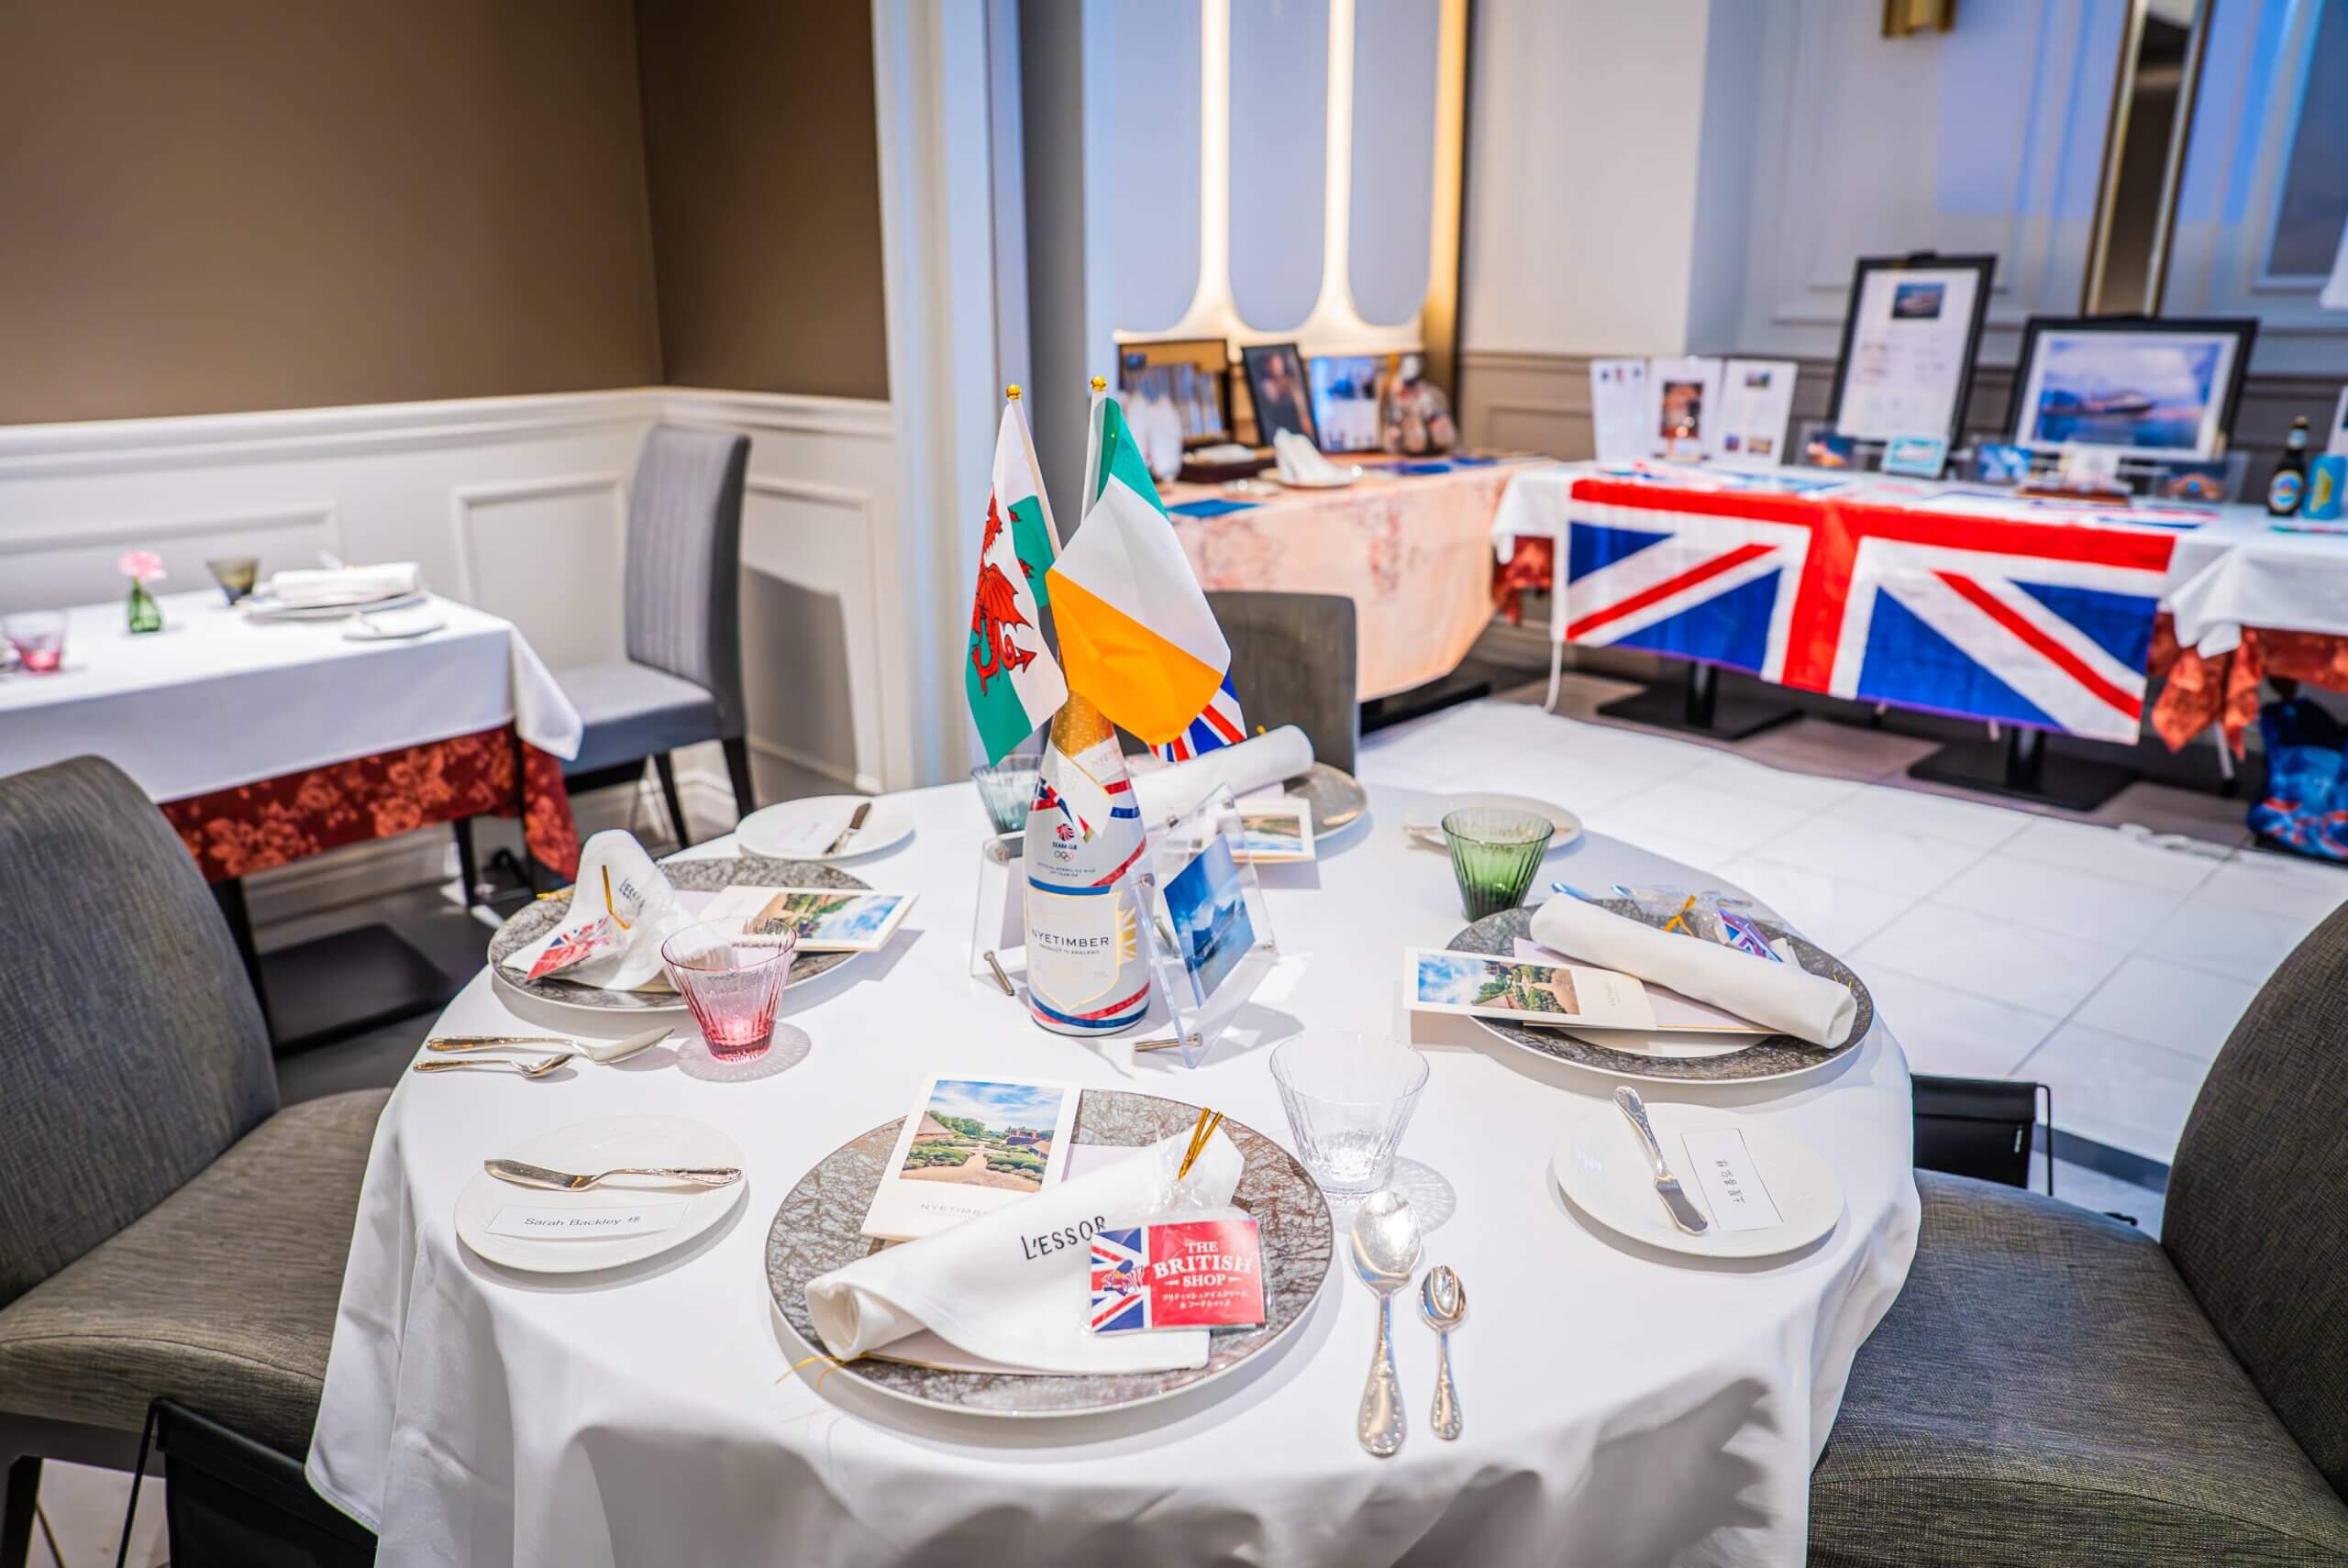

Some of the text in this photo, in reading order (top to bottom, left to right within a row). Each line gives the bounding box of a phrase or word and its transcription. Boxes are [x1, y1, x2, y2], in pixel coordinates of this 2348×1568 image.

[1032, 928, 1109, 947] NYETIMBER
[524, 1218, 564, 1226] Sarah
[569, 1218, 622, 1226] Backley
[1020, 1215, 1106, 1261] L'ESSOR
[1184, 1240, 1219, 1254] THE
[1152, 1254, 1251, 1279] BRITISH
[1182, 1274, 1226, 1287] SHOP
